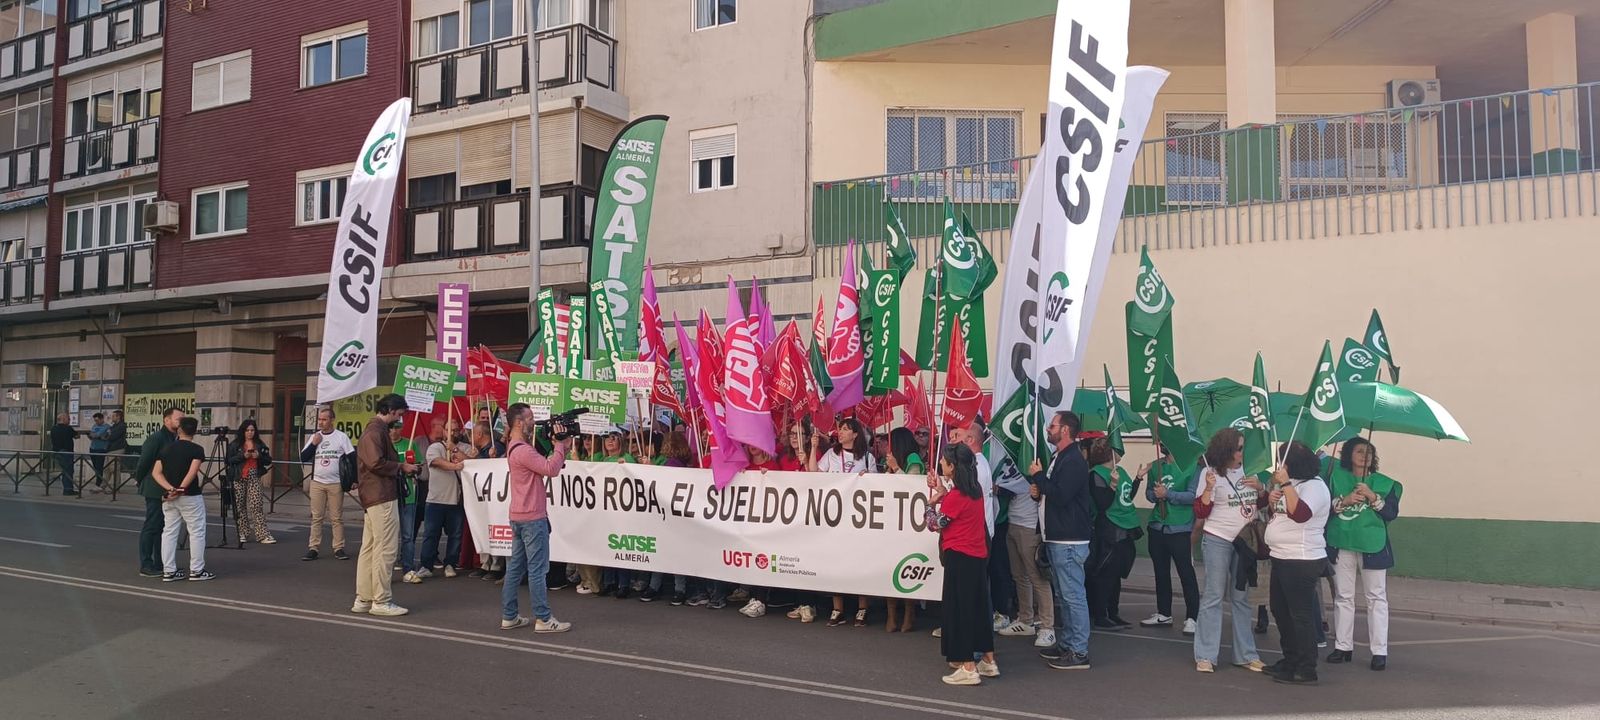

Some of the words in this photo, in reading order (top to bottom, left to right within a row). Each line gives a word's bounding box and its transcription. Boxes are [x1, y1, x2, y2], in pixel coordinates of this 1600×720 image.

[1056, 18, 1117, 225] CSIF
[617, 138, 655, 154] SATSE
[615, 152, 651, 164] ALMERÍA
[338, 203, 378, 314] CSIF
[879, 284, 896, 296] CSIF
[442, 288, 463, 371] CCOO
[541, 302, 557, 375] SATS
[594, 293, 620, 370] SATS
[568, 310, 583, 380] SATS
[881, 310, 891, 383] CSIF
[335, 353, 369, 368] CSIF
[1351, 352, 1375, 368] CSIF
[403, 364, 451, 384] SATSE
[596, 367, 613, 381] SATS
[1144, 338, 1158, 409] CSIF
[404, 381, 443, 393] ALMERÍA
[515, 381, 560, 397] SATSE
[1315, 373, 1339, 407] CSI
[518, 396, 555, 406] ALMERÍA
[570, 387, 621, 406] SATSE
[150, 398, 195, 415] DISPONIBLE
[473, 472, 493, 502] LA
[560, 474, 596, 510] NOS
[603, 477, 665, 521] ROBA,
[671, 482, 695, 518] EL
[703, 485, 798, 525] SUELDO
[805, 488, 843, 528] NO
[851, 489, 885, 530] SE
[893, 491, 930, 533] TO
[608, 533, 657, 553] SATSE
[614, 552, 650, 563] ALMERÍA
[722, 550, 752, 568] UGT
[900, 565, 934, 581] CSIF
